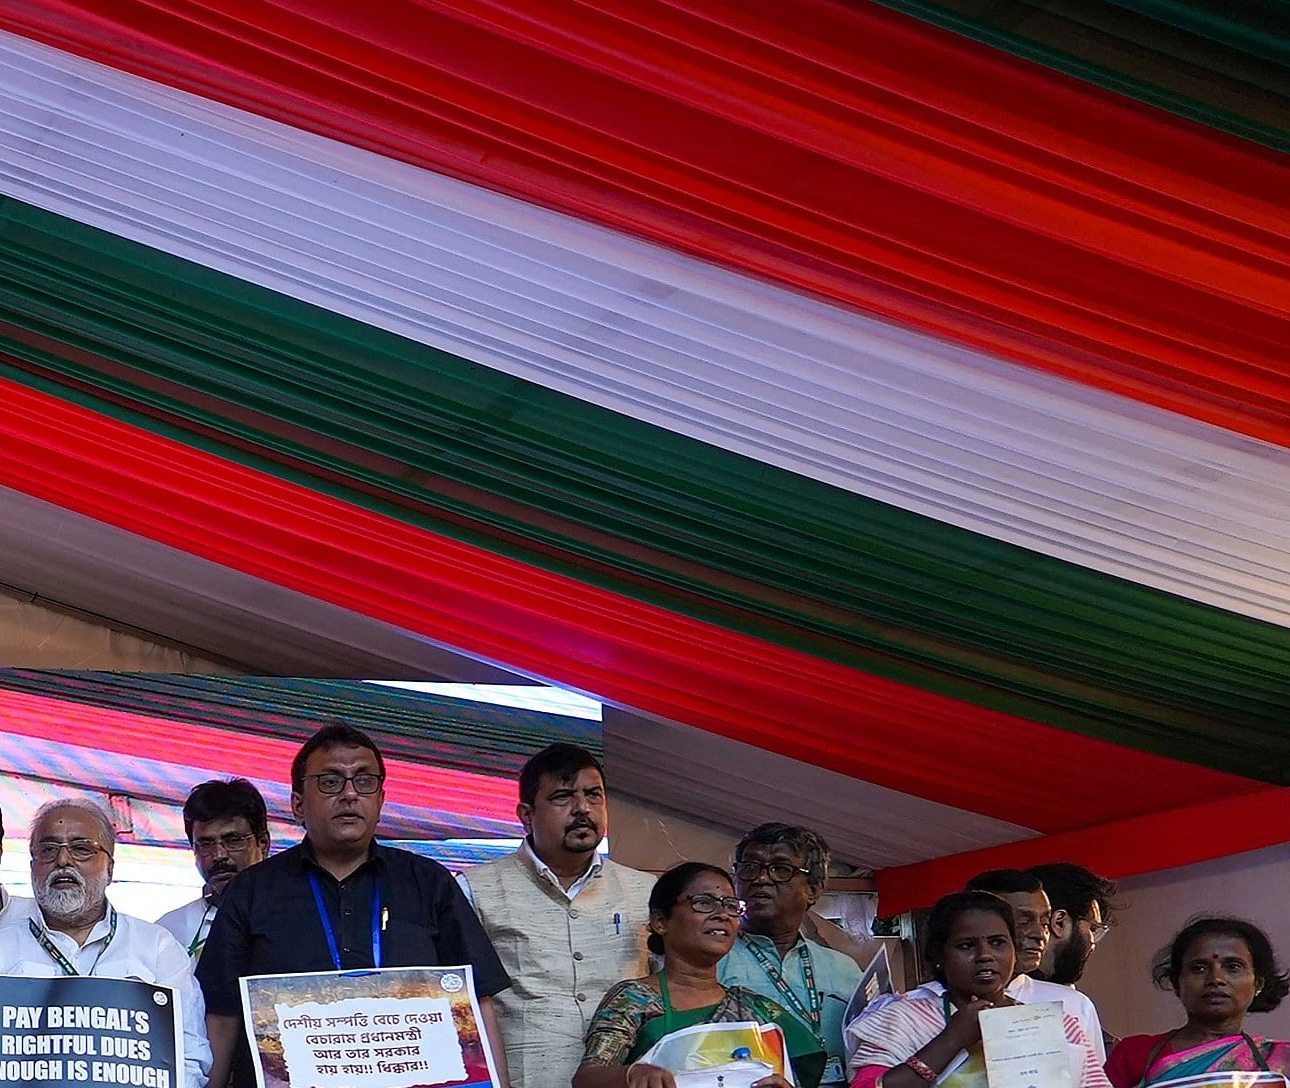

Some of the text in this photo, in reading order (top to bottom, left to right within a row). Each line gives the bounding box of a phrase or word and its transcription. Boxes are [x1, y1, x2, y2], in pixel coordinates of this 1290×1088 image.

[2, 1005, 150, 1035] PAY BENGAL'S
[283, 1012, 443, 1030] দেশীয় সম্পত্তি বেচে দেওয়া
[306, 1026, 422, 1045] বেচারাম প্রধানমন্ত্রী
[1, 1034, 151, 1061] RIGHTFUL DUES
[313, 1045, 421, 1060] আর তার সরকার
[68, 1060, 88, 1081] IS
[315, 1063, 338, 1076] হায়
[343, 1062, 373, 1075] হায়!!
